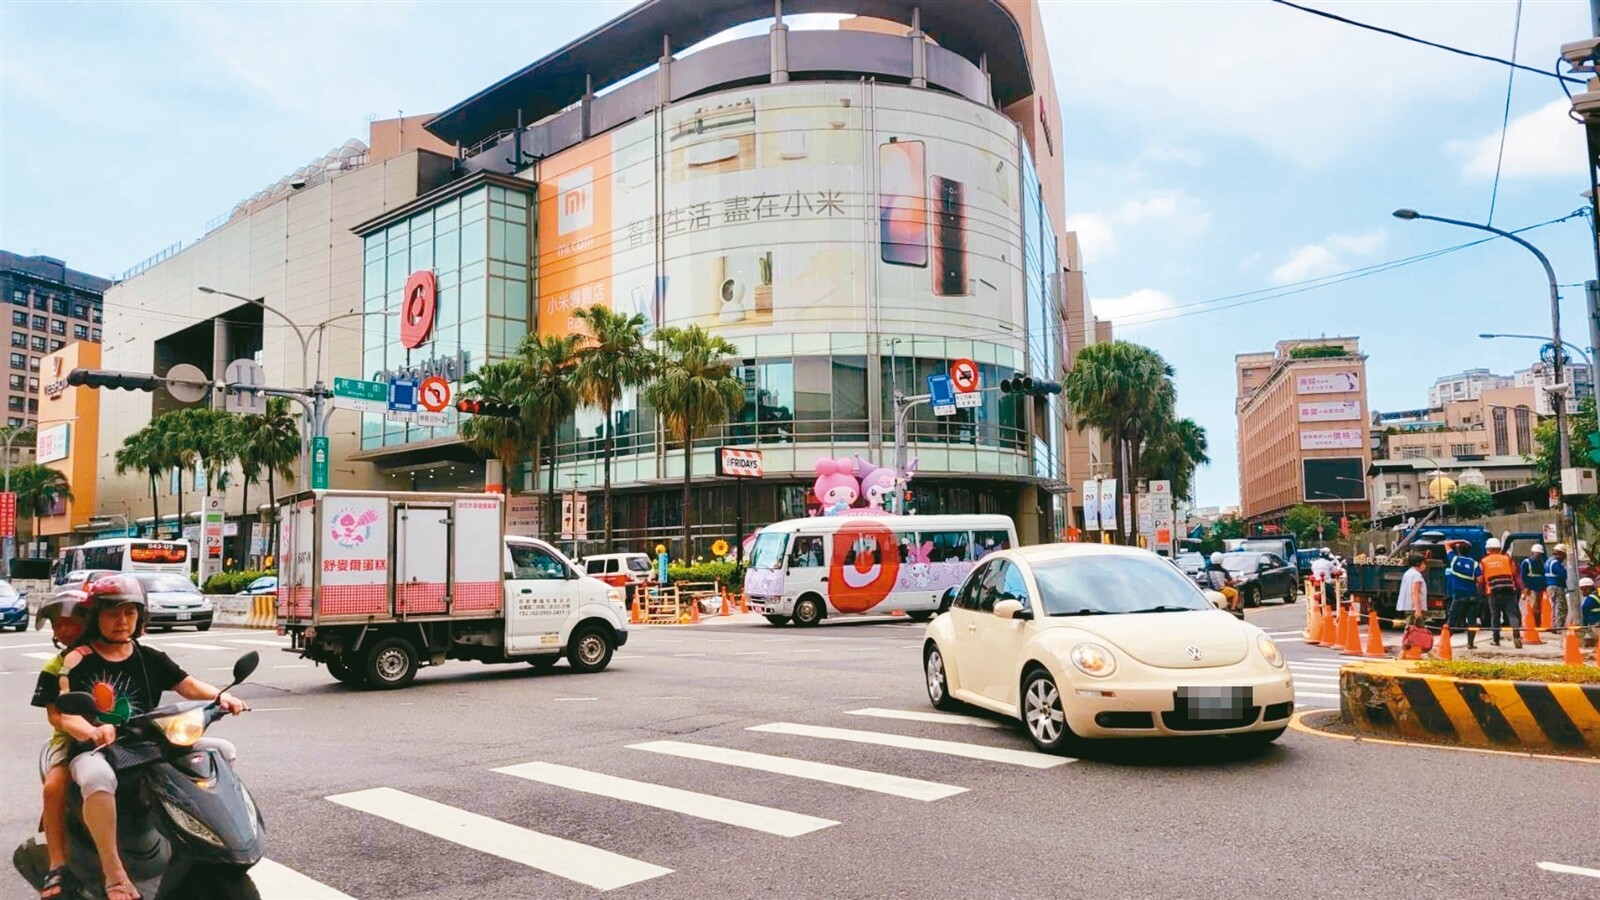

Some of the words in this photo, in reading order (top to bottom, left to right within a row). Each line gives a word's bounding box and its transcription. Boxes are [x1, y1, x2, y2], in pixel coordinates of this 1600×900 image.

[628, 200, 712, 248] 智慧生活
[723, 188, 845, 224] 盡在小米
[730, 458, 758, 469] FRIDAYS
